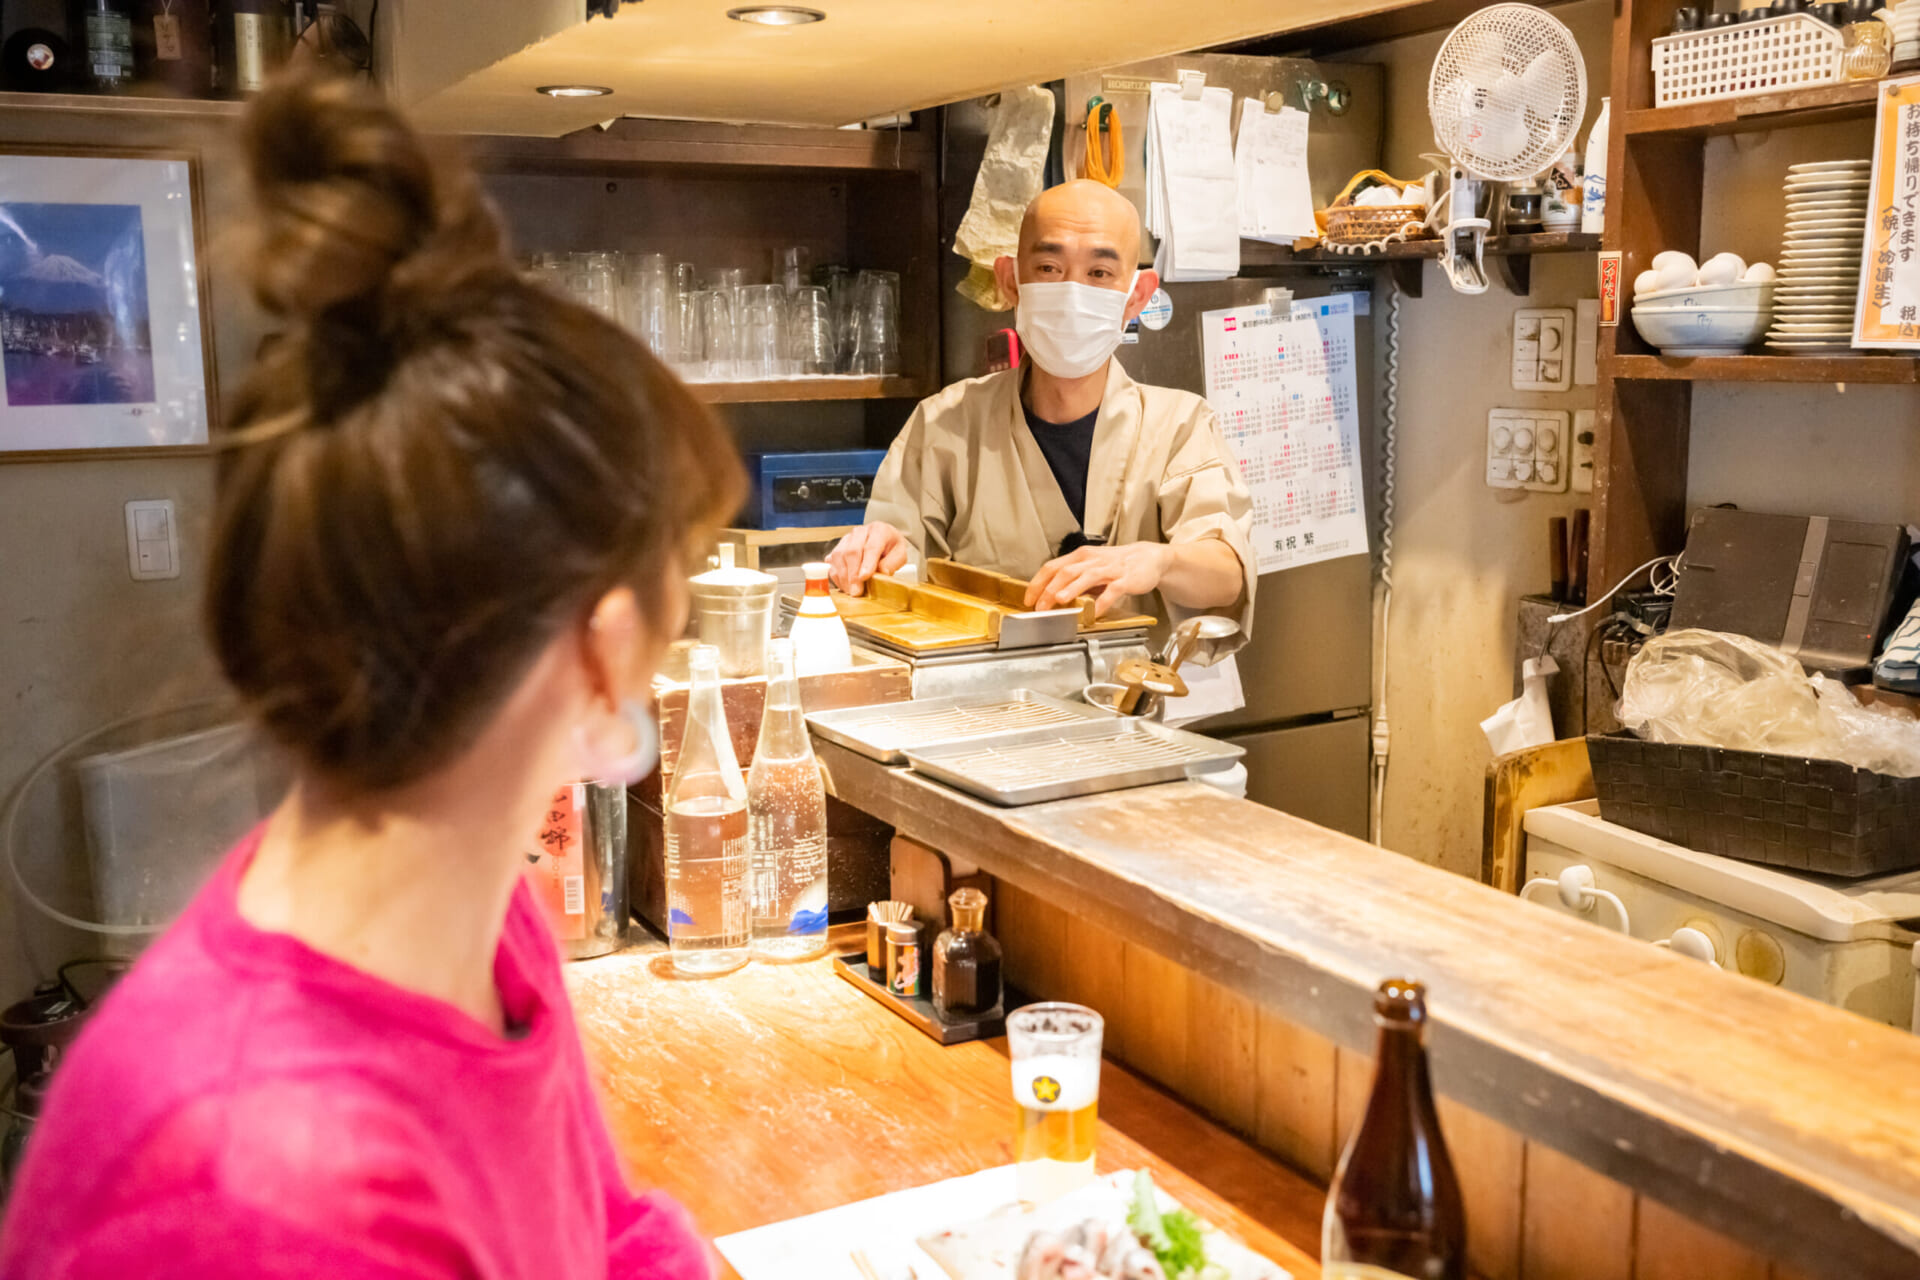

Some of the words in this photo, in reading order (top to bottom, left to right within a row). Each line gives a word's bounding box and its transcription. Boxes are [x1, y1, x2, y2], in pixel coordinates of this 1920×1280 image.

[1898, 103, 1920, 262] お持ち帰りできます
[1897, 305, 1917, 337] 税込
